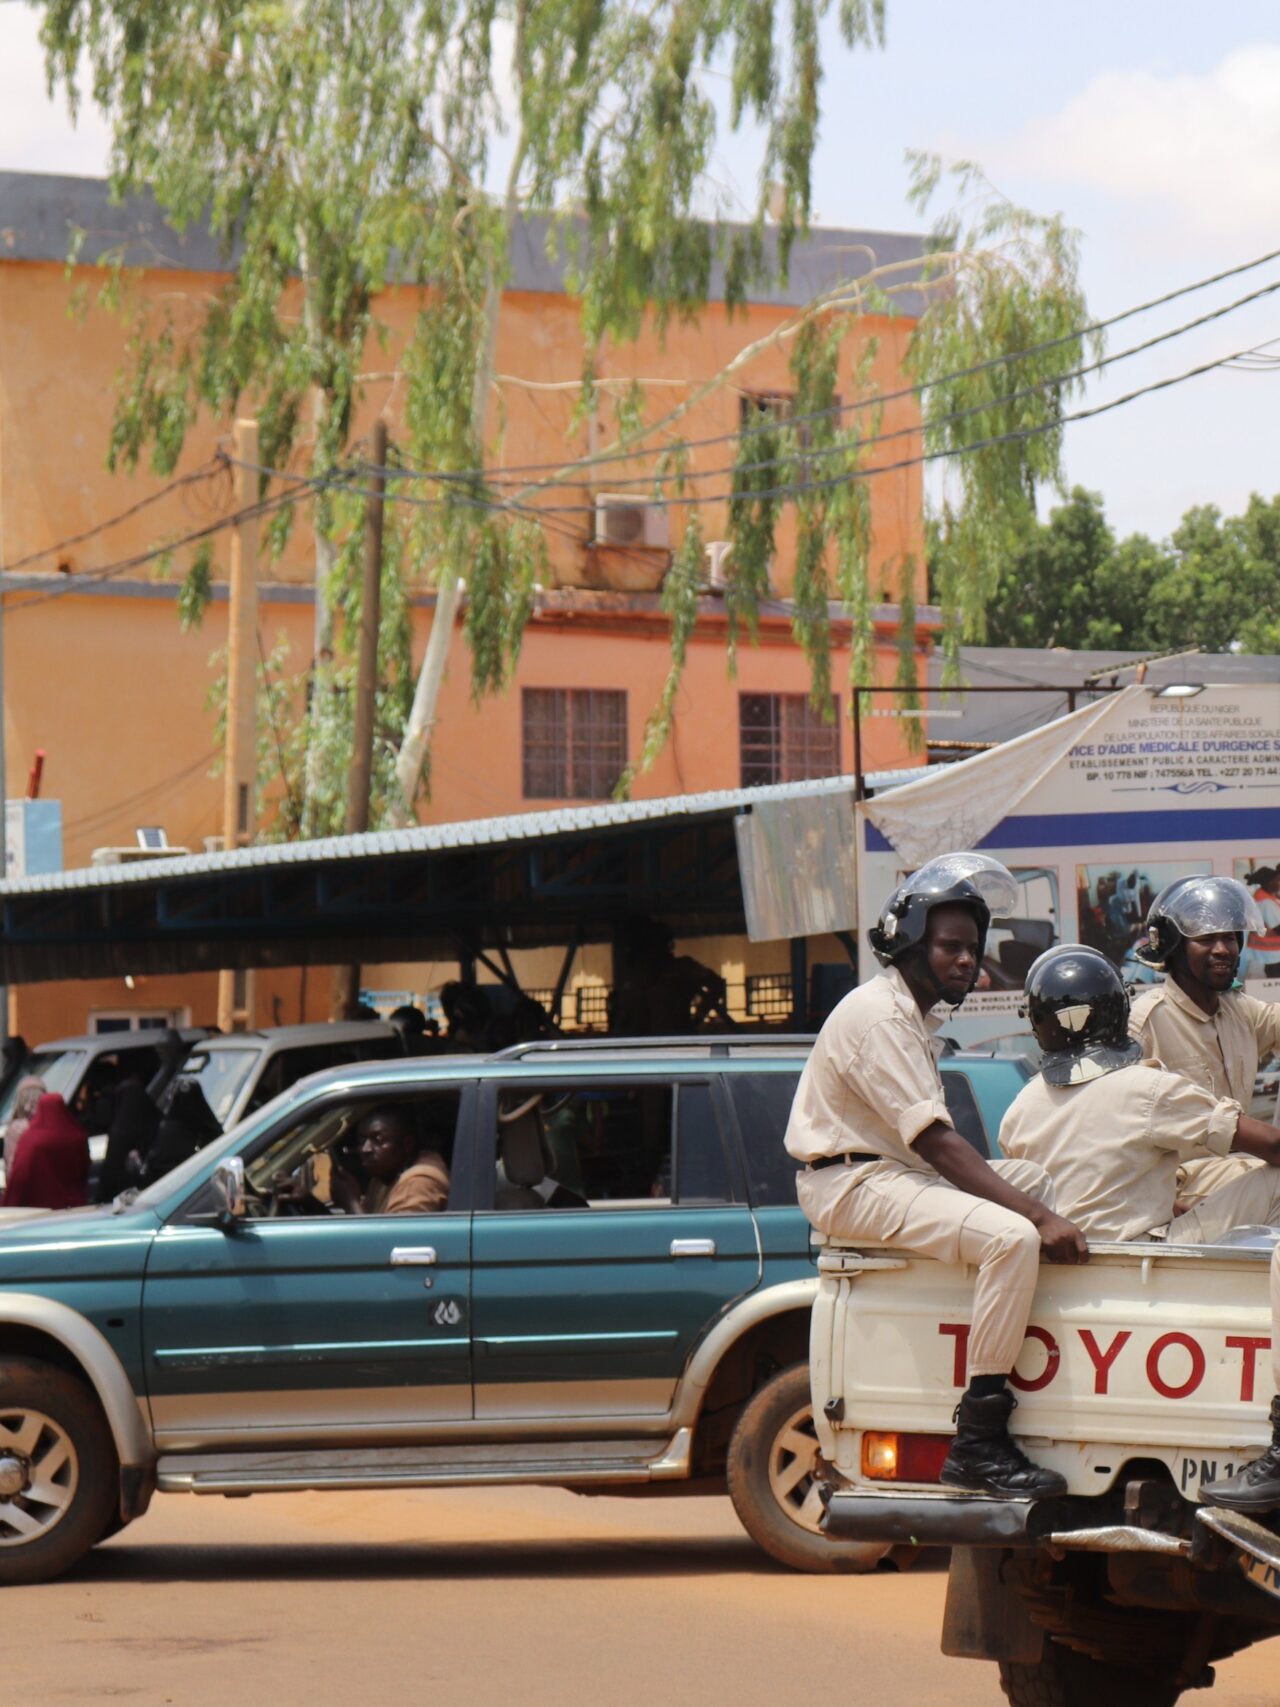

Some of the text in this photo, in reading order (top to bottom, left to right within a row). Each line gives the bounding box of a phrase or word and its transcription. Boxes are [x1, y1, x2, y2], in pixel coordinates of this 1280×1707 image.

[1150, 703, 1241, 714] REPUBLIQUE DU NIGER
[1128, 718, 1169, 728] MINISTERE
[1172, 718, 1183, 726] DE
[1184, 718, 1195, 726] LA
[1223, 716, 1263, 726] PUBLIQUE
[1104, 733, 1114, 742] DE
[1126, 731, 1179, 741] POPULATION
[1180, 730, 1191, 739] ET
[1191, 730, 1207, 739] DES
[1209, 729, 1246, 739] AFFAIRES
[1066, 744, 1095, 757] VICE
[1098, 743, 1137, 755] D'AIDE
[1139, 741, 1200, 754] MEDICALE
[1202, 740, 1271, 752] D'URGENCE
[1152, 755, 1185, 765] PUBLIC
[1181, 1457, 1217, 1492] PN
